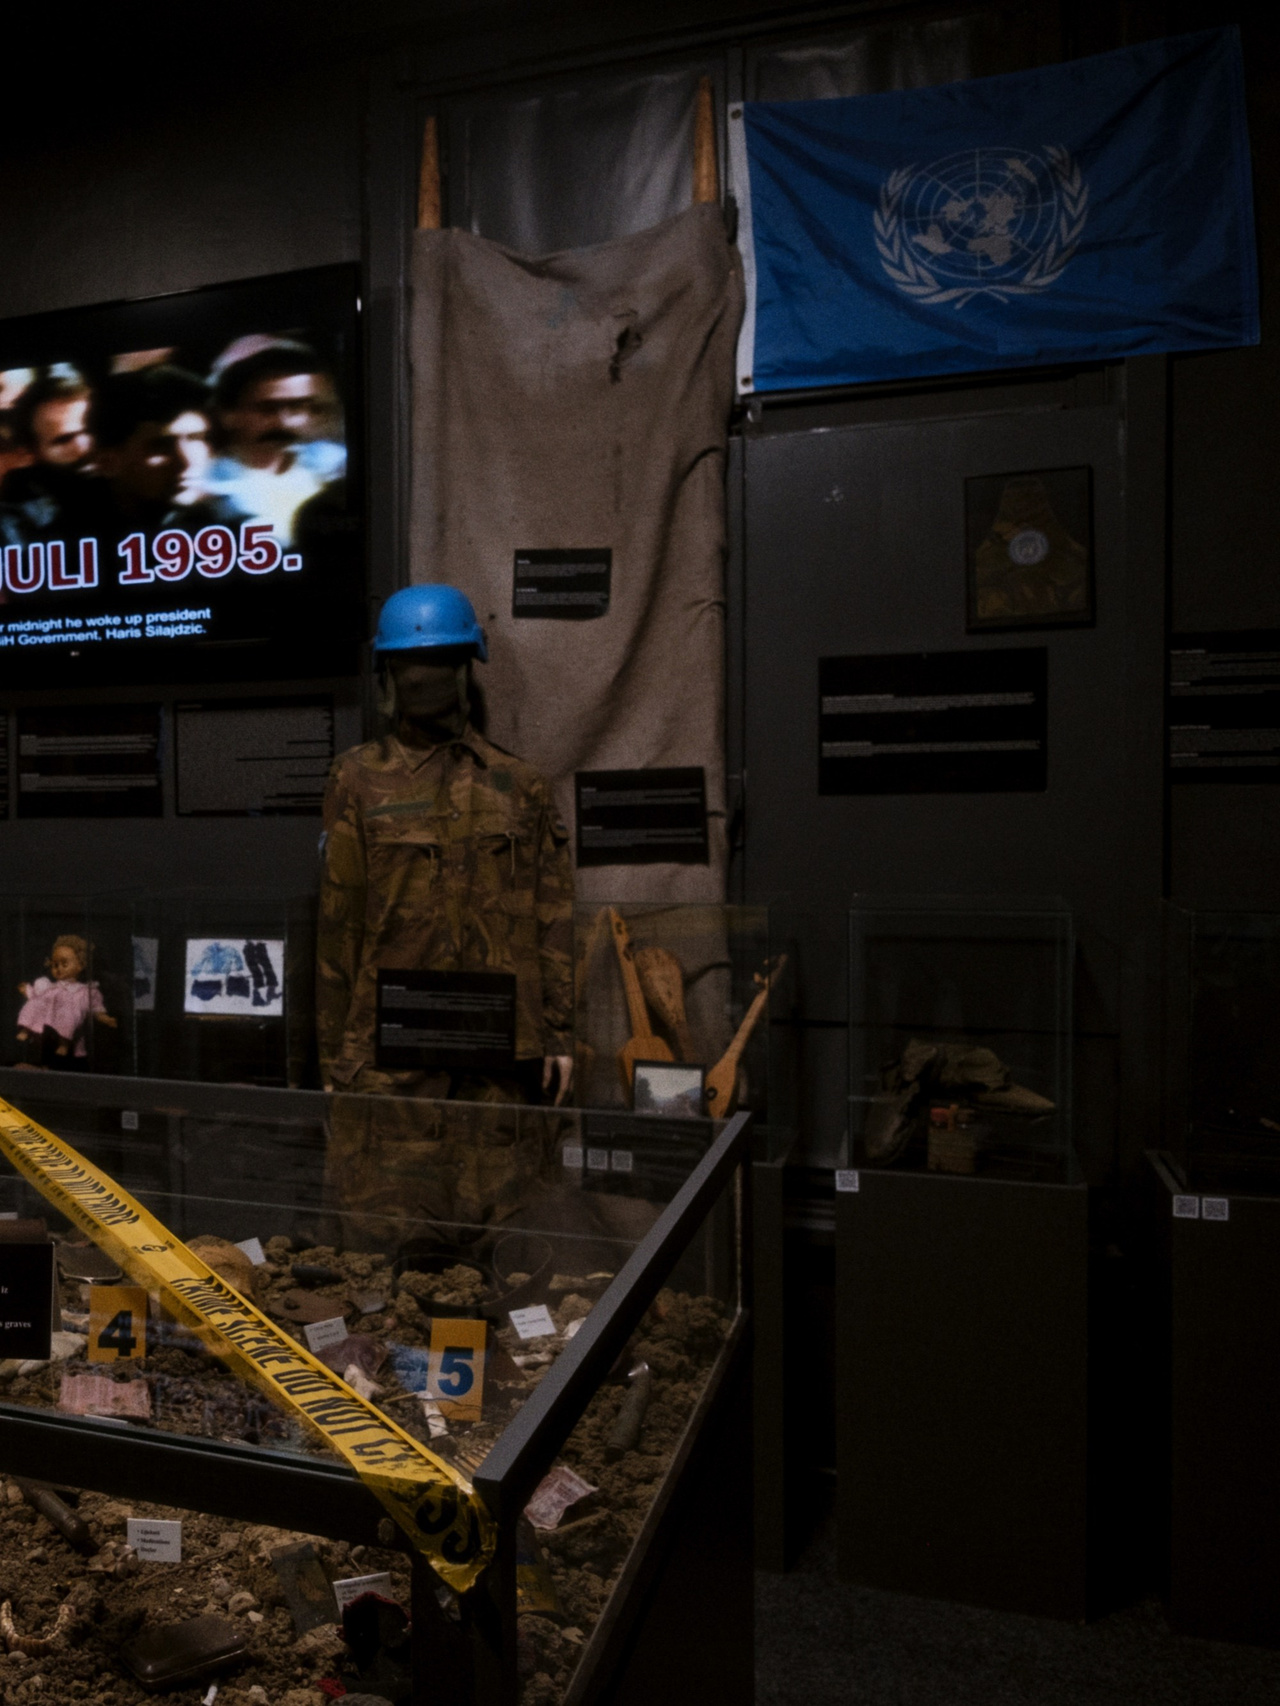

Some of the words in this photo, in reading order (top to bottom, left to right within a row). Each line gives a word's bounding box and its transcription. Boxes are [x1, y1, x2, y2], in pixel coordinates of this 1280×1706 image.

[118, 523, 302, 584] 1995.
[7, 618, 62, 634] midnight
[65, 616, 83, 629] he
[86, 614, 121, 628] woke
[125, 614, 143, 627] up
[146, 608, 211, 625] president
[18, 629, 102, 646] Government,
[106, 627, 141, 640] Haris
[145, 622, 207, 639] Silajdzic.
[170, 1276, 254, 1317] CRIME
[4, 1321, 32, 1330] graves
[98, 1310, 137, 1357] 4
[219, 1319, 309, 1369] SCENE
[273, 1369, 343, 1396] DO
[438, 1346, 475, 1396] 5
[300, 1396, 394, 1436] NOT
